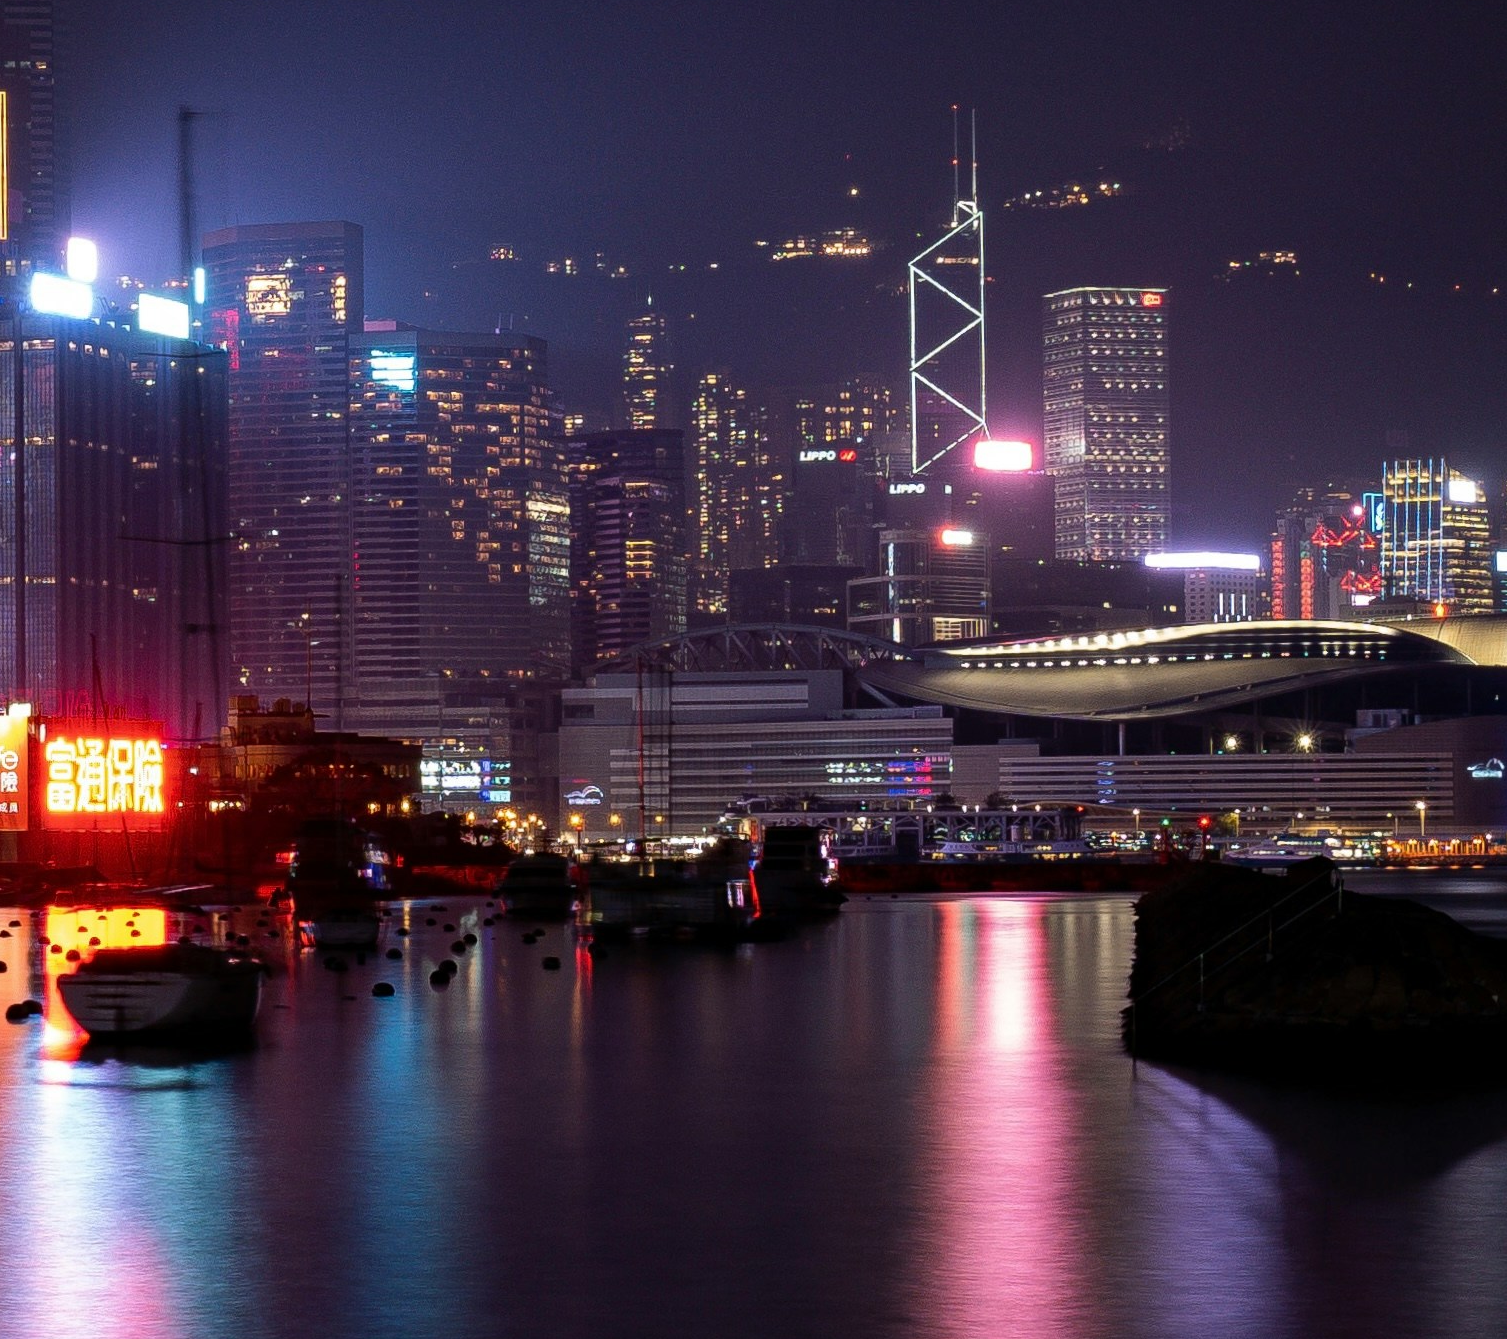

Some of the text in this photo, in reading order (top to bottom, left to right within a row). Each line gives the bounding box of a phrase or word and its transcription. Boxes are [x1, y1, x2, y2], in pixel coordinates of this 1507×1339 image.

[799, 450, 836, 461] LIPPO
[889, 484, 925, 495] LIPPO
[46, 737, 163, 812] 富通保險
